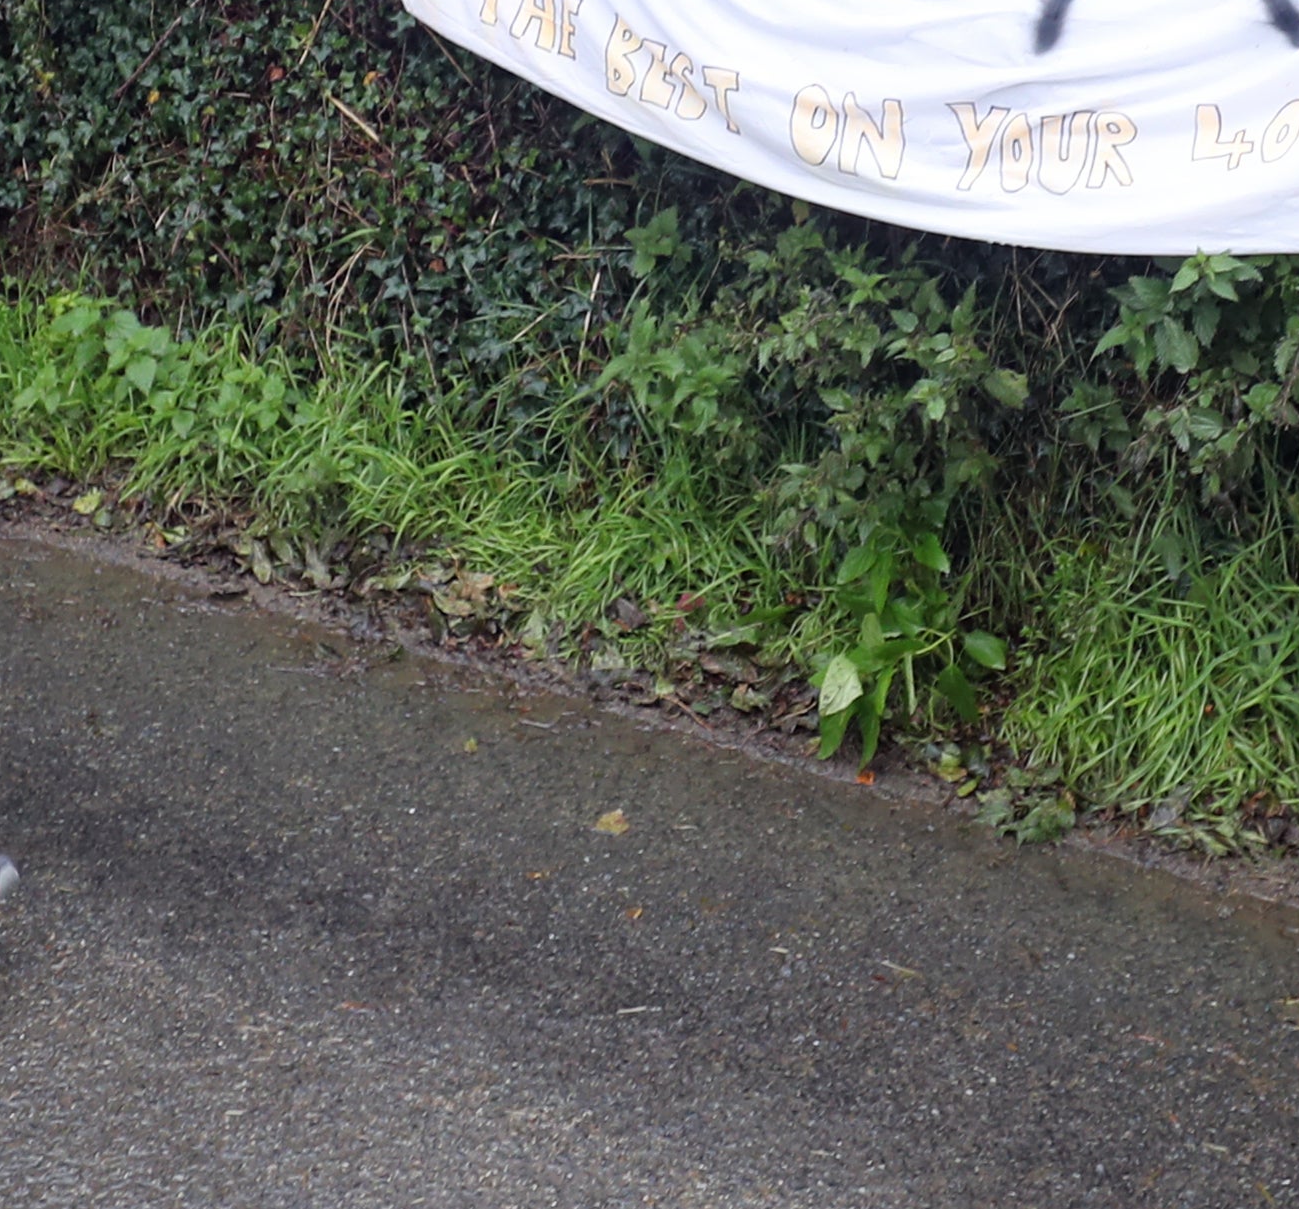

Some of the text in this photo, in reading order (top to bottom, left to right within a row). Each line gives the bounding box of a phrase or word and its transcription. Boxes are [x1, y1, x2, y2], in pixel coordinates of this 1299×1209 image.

[605, 14, 741, 135] BEST
[790, 84, 905, 180] ON
[945, 100, 1138, 195] YOUR
